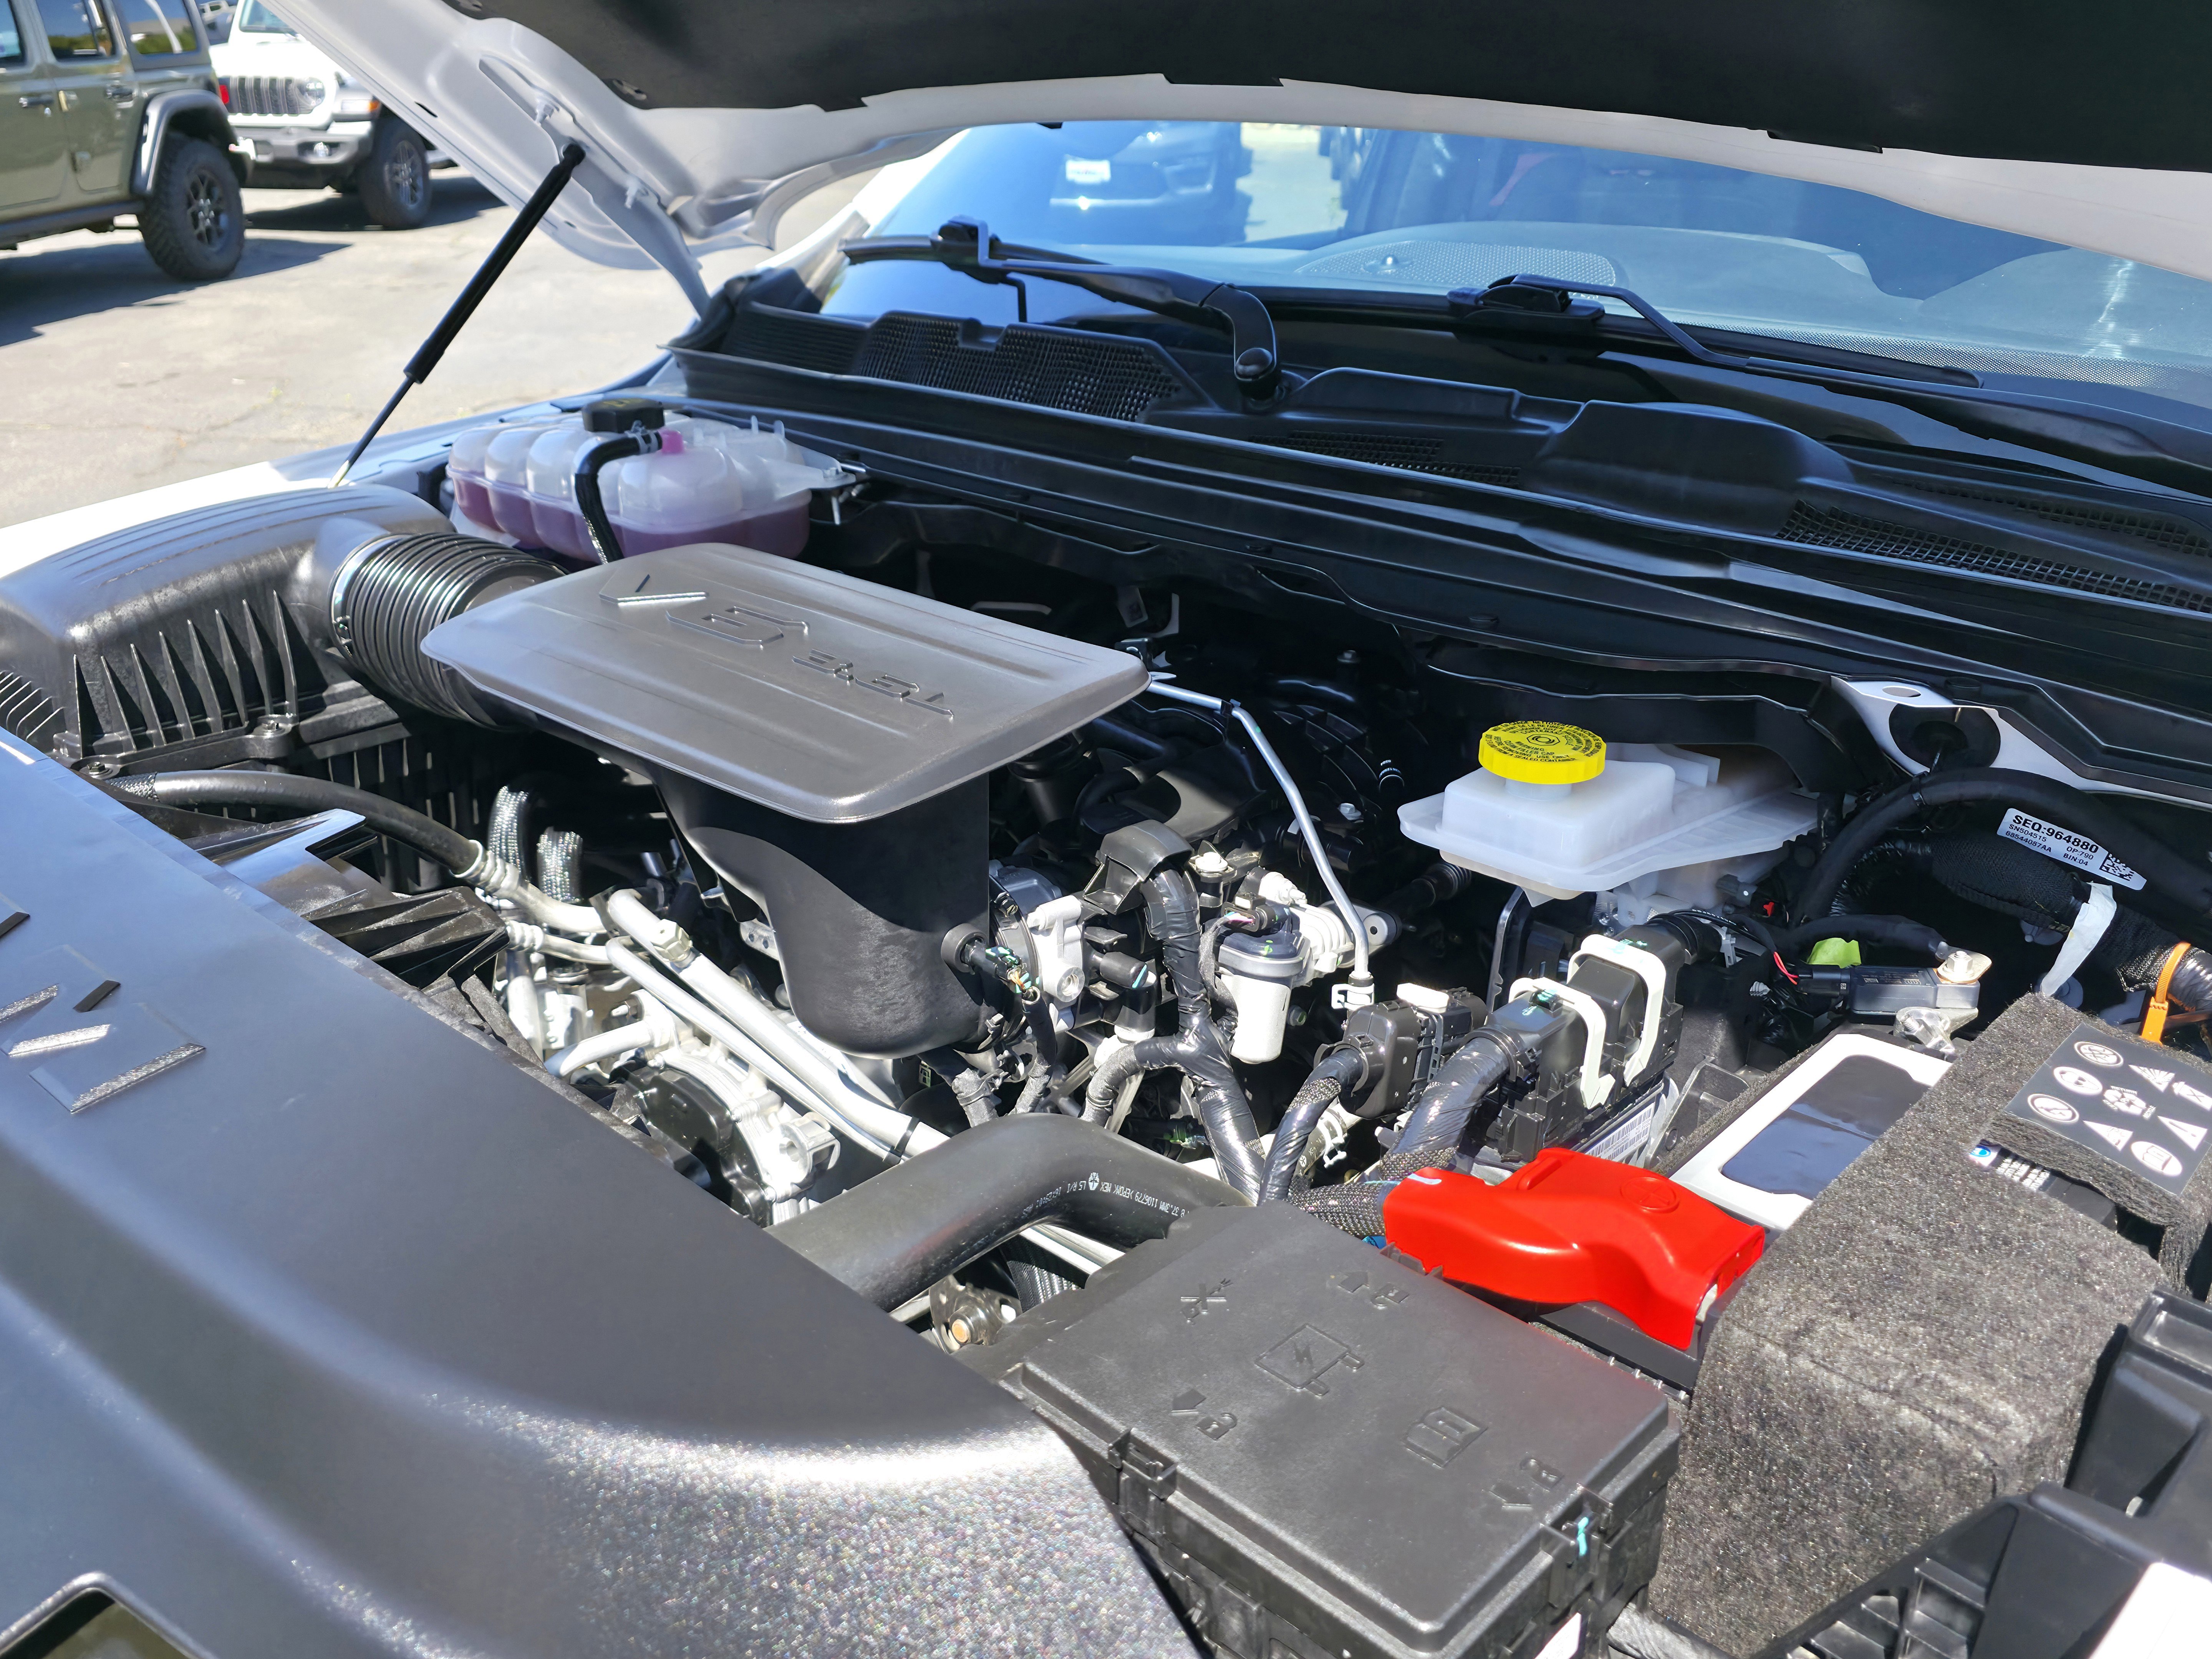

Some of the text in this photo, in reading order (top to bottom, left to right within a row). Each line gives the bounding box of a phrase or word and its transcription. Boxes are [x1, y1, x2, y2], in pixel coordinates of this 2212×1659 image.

[2005, 830, 2088, 866] 68544087AA BIN:04
[2009, 824, 2094, 860] SN504515 OP:790
[2013, 815, 2099, 853] SEQ:964880
